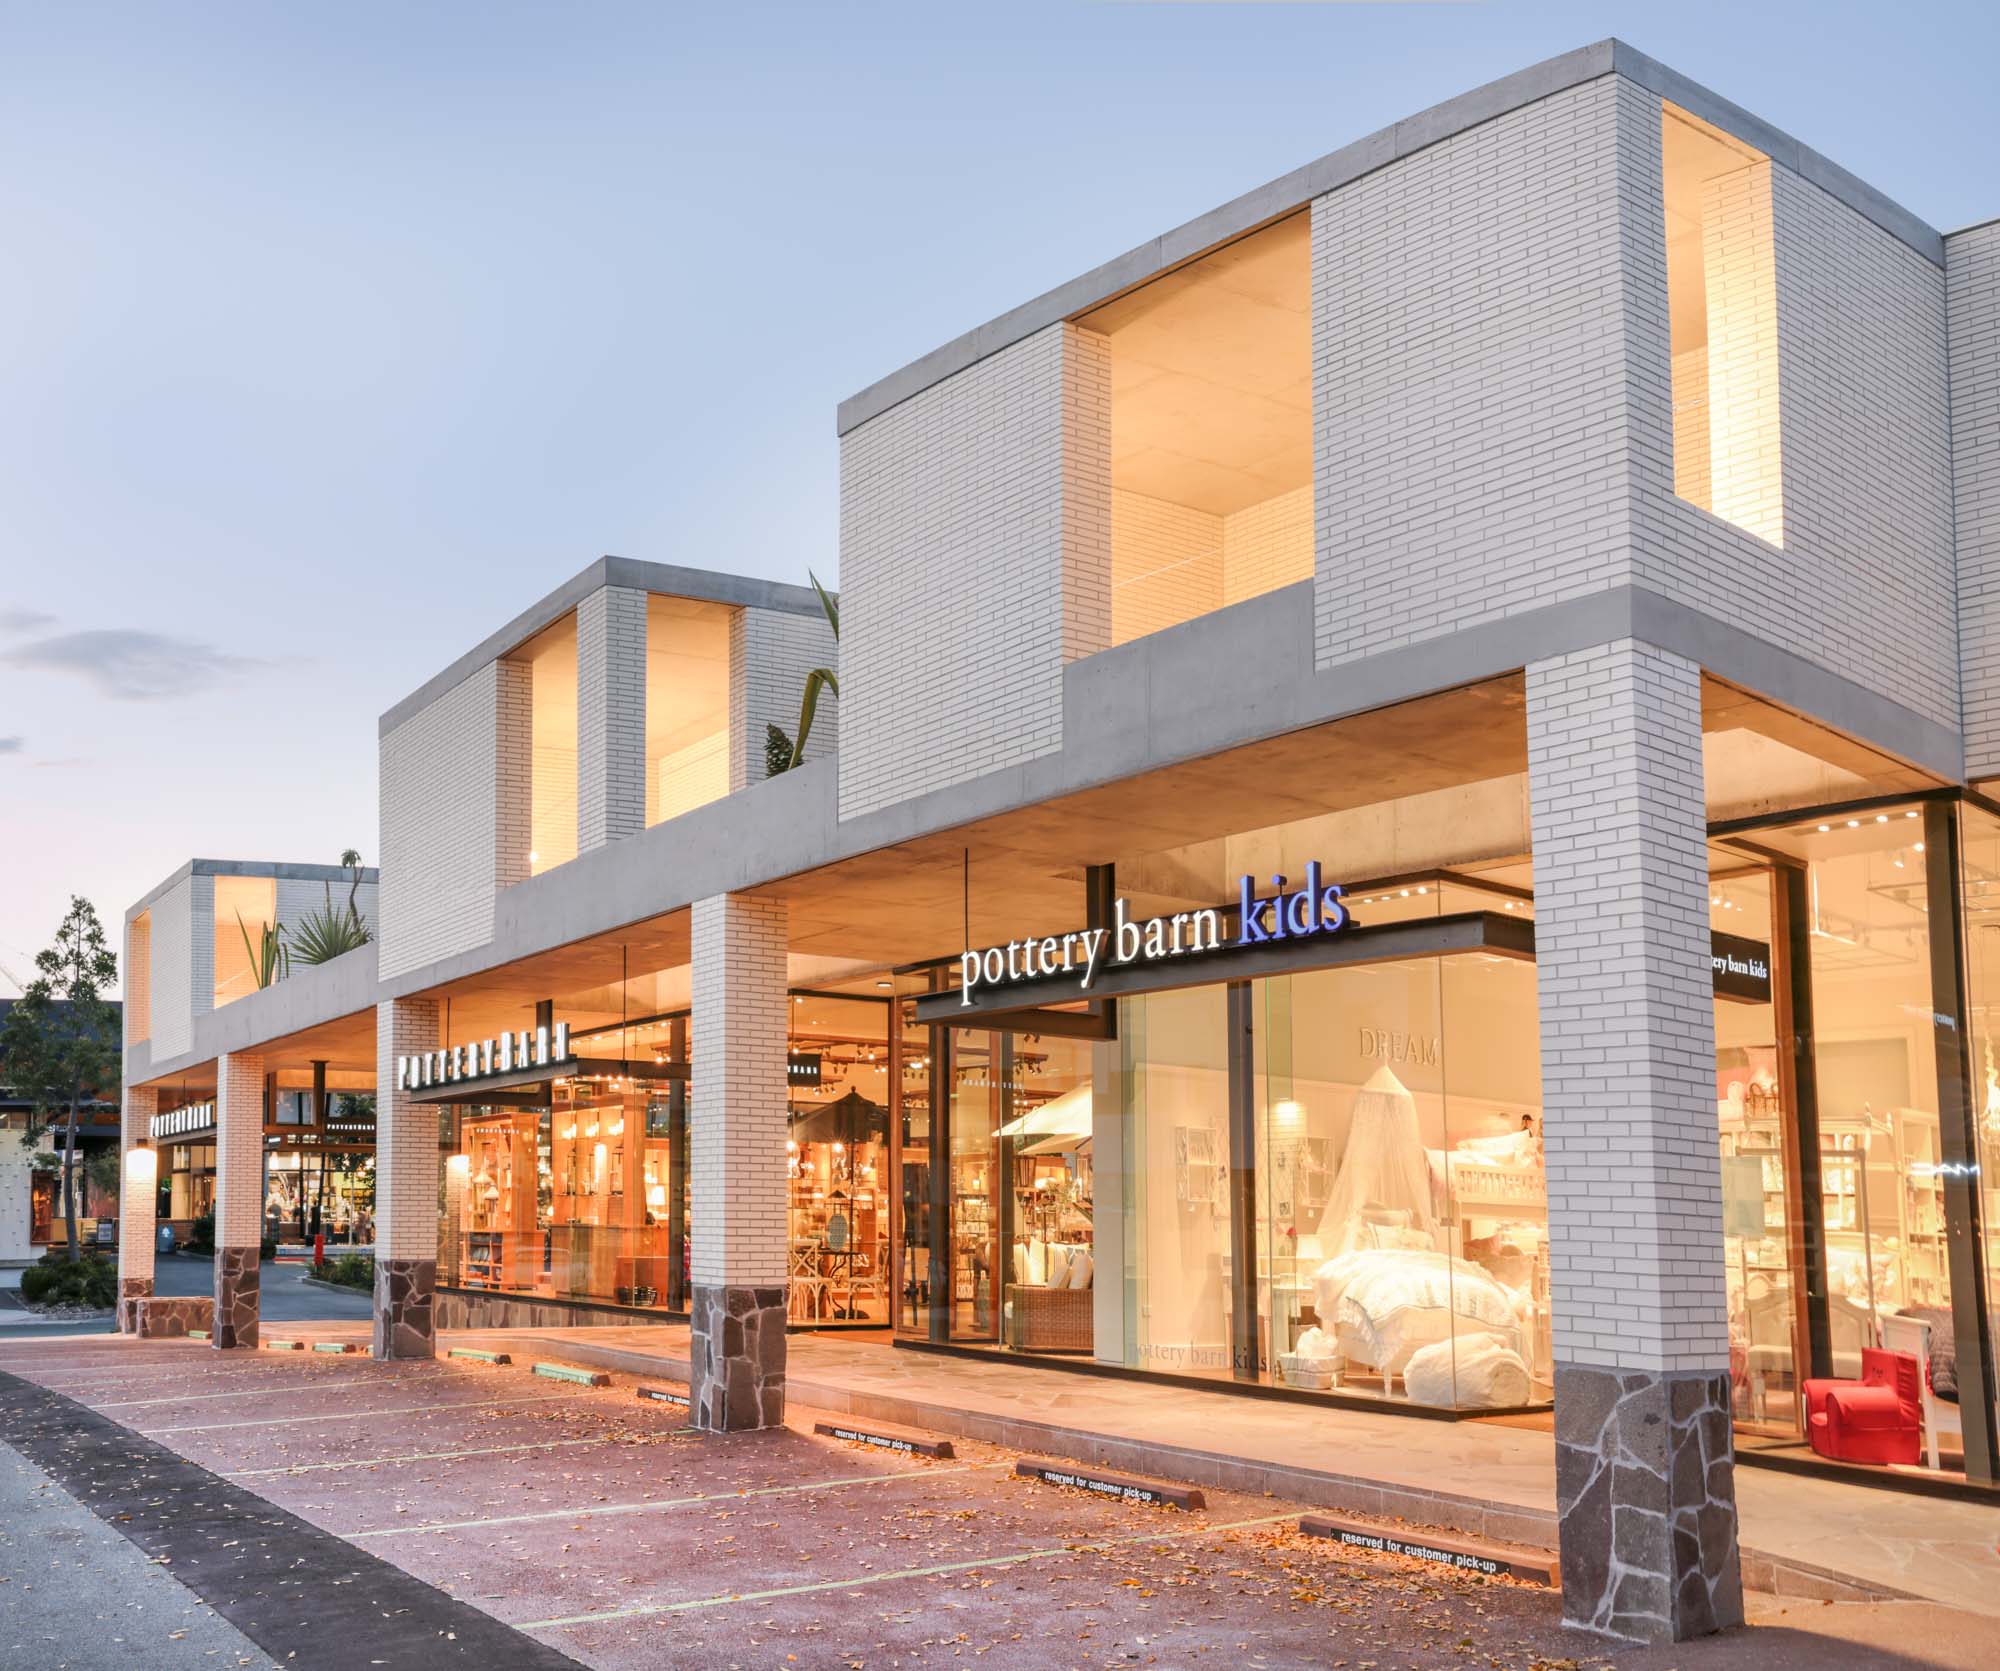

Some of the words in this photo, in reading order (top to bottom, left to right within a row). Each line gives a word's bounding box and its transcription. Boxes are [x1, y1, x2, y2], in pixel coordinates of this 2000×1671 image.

[961, 929, 1103, 1007] pottery
[1114, 897, 1222, 962] barn
[1238, 860, 1347, 945] kids
[1728, 953, 1748, 975] barn
[1749, 958, 1767, 979] kids
[1359, 1027, 1439, 1066] DREAM
[835, 1429, 857, 1440] reserved
[858, 1433, 866, 1442] for
[866, 1435, 891, 1447] customer
[891, 1439, 912, 1451] pick-up
[1045, 1471, 1074, 1485] reserved
[1076, 1477, 1086, 1487] for
[1088, 1481, 1122, 1494] customer
[1124, 1486, 1152, 1502] pick-up
[1341, 1532, 1383, 1549] reserved
[1386, 1539, 1402, 1553] for
[1404, 1545, 1453, 1563] customer
[1456, 1555, 1497, 1573] pick-up
